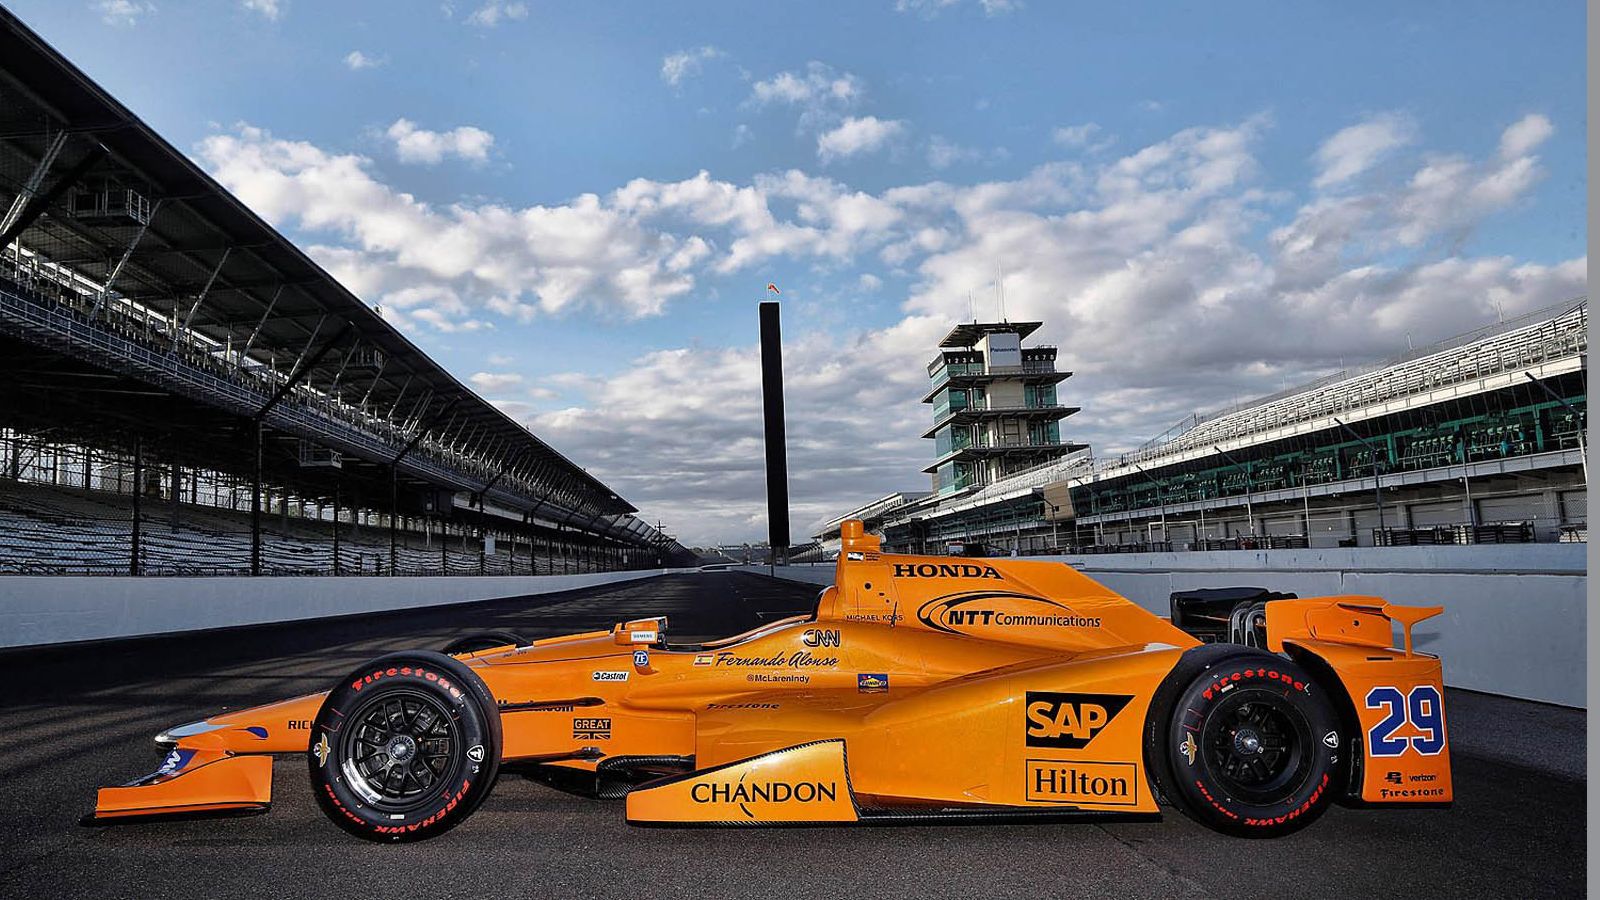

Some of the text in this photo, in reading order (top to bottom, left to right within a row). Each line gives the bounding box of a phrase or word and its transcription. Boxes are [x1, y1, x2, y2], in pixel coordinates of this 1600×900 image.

[893, 564, 1004, 579] HONDA
[948, 610, 1101, 628] NTT Communications
[803, 629, 841, 648] CNN
[715, 651, 840, 668] Fernando Alonso
[352, 666, 461, 698] Firestone
[600, 672, 627, 681] Castrol
[746, 674, 810, 684] @McLarenIndy
[1202, 668, 1304, 700] Firestone
[574, 719, 610, 730] GREAT
[1027, 701, 1108, 739] SAP
[1365, 685, 1446, 758] 29
[1034, 768, 1128, 796] Hilton
[1409, 773, 1437, 782] verizon
[690, 782, 836, 804] CHANDON
[1243, 772, 1330, 826] FIREHAWK
[1380, 788, 1444, 799] Firestone
[374, 779, 471, 834] FIREHAWK
